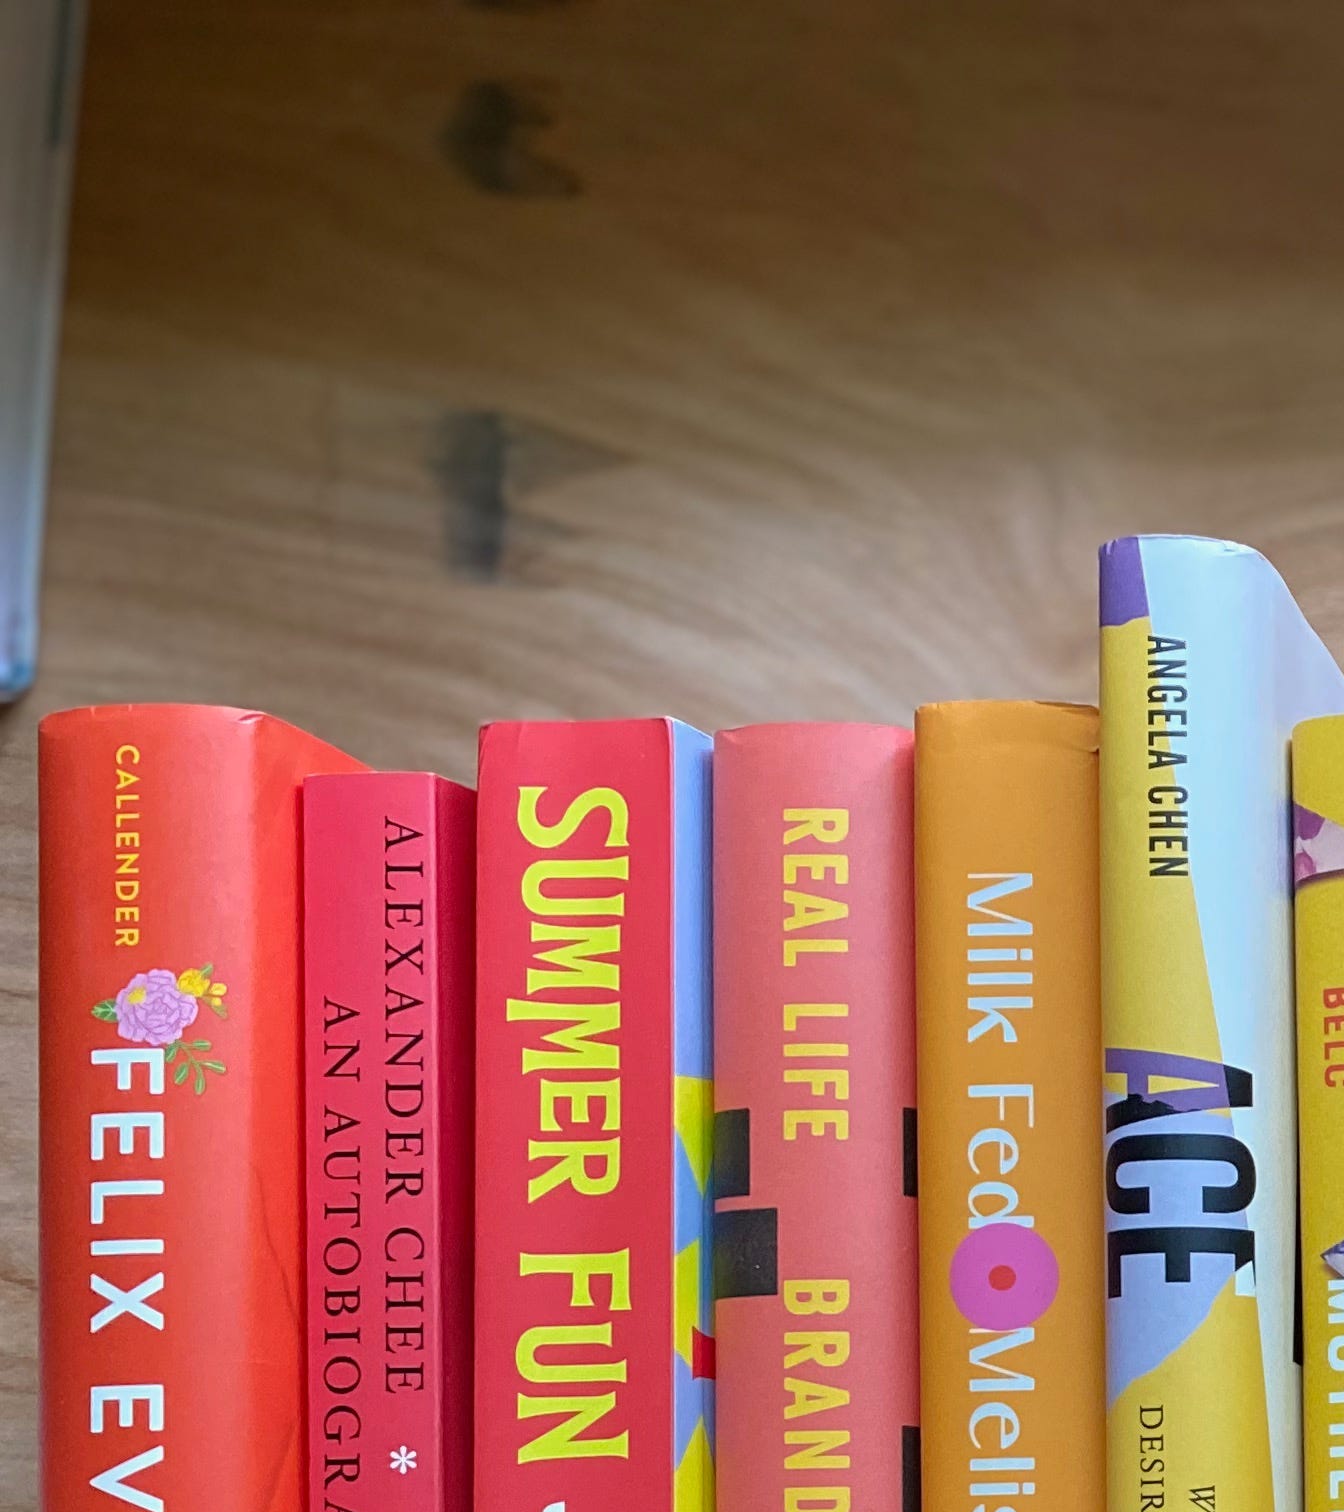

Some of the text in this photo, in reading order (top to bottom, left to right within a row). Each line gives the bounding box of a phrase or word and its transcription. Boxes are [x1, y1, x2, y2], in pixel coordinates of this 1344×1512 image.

[1147, 635, 1190, 877] ANGELA CHEN
[115, 744, 140, 947] CALLENDER
[783, 807, 849, 966] REAL
[323, 996, 361, 1083] AN
[384, 816, 425, 1203] ALEXANDER
[967, 873, 1032, 1042] Milk
[506, 785, 632, 1464] SUMMER FUN
[783, 1003, 849, 1140] LIFE
[967, 1083, 1034, 1229] Fed
[90, 1047, 164, 1333] FELIX
[384, 1225, 425, 1393] CHEE
